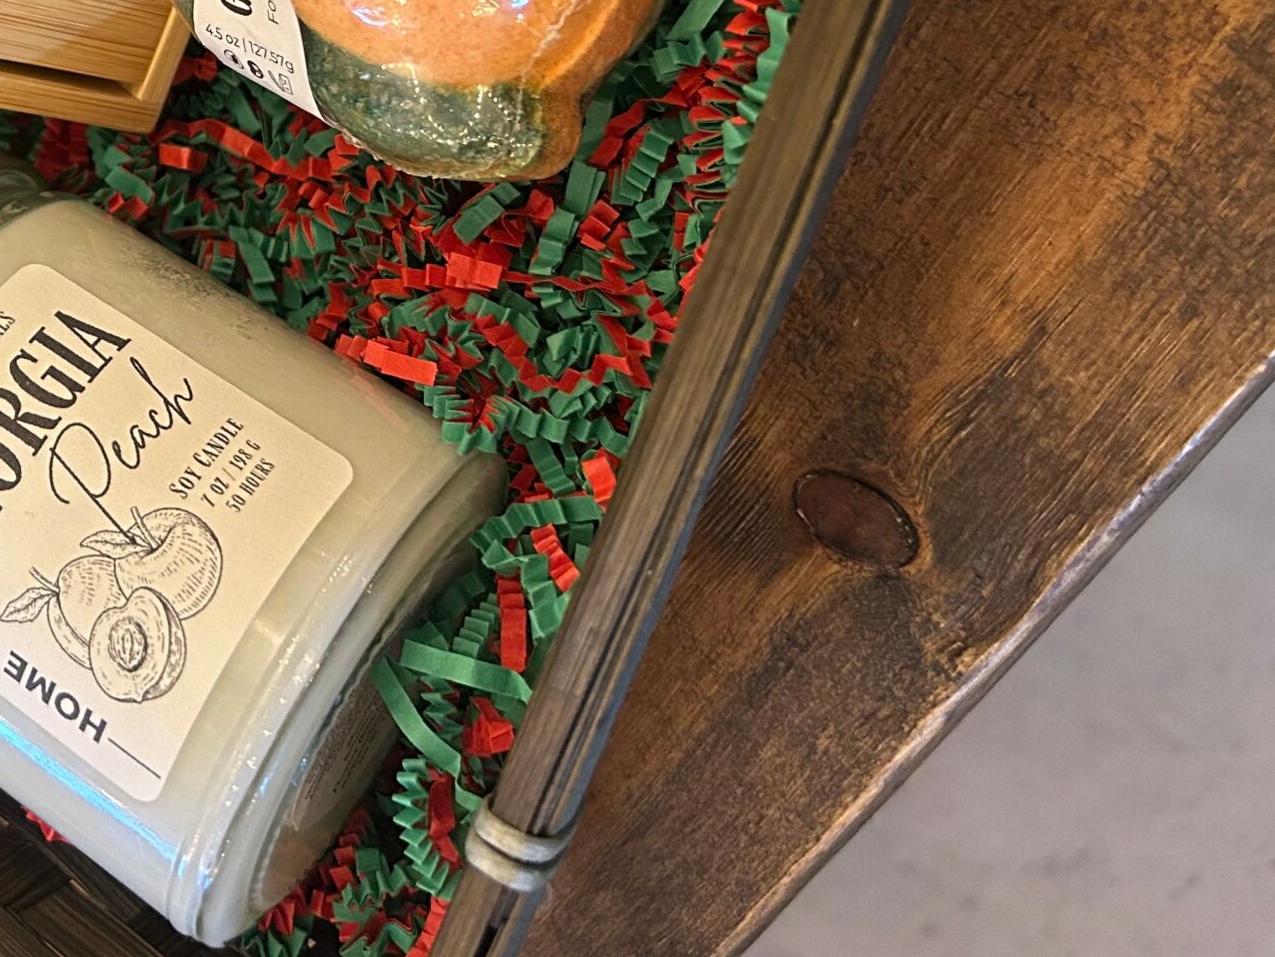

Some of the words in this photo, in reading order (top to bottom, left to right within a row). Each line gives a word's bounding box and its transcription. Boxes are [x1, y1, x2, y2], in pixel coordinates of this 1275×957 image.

[48, 357, 195, 544] Peach
[168, 465, 202, 500] SOY
[192, 417, 244, 468] CANDLE
[200, 492, 215, 508] 7
[209, 476, 230, 496] OZ
[229, 448, 253, 472] 198
[225, 493, 246, 513] 50
[239, 457, 275, 496] HOURS
[2, 649, 108, 743] HOME
